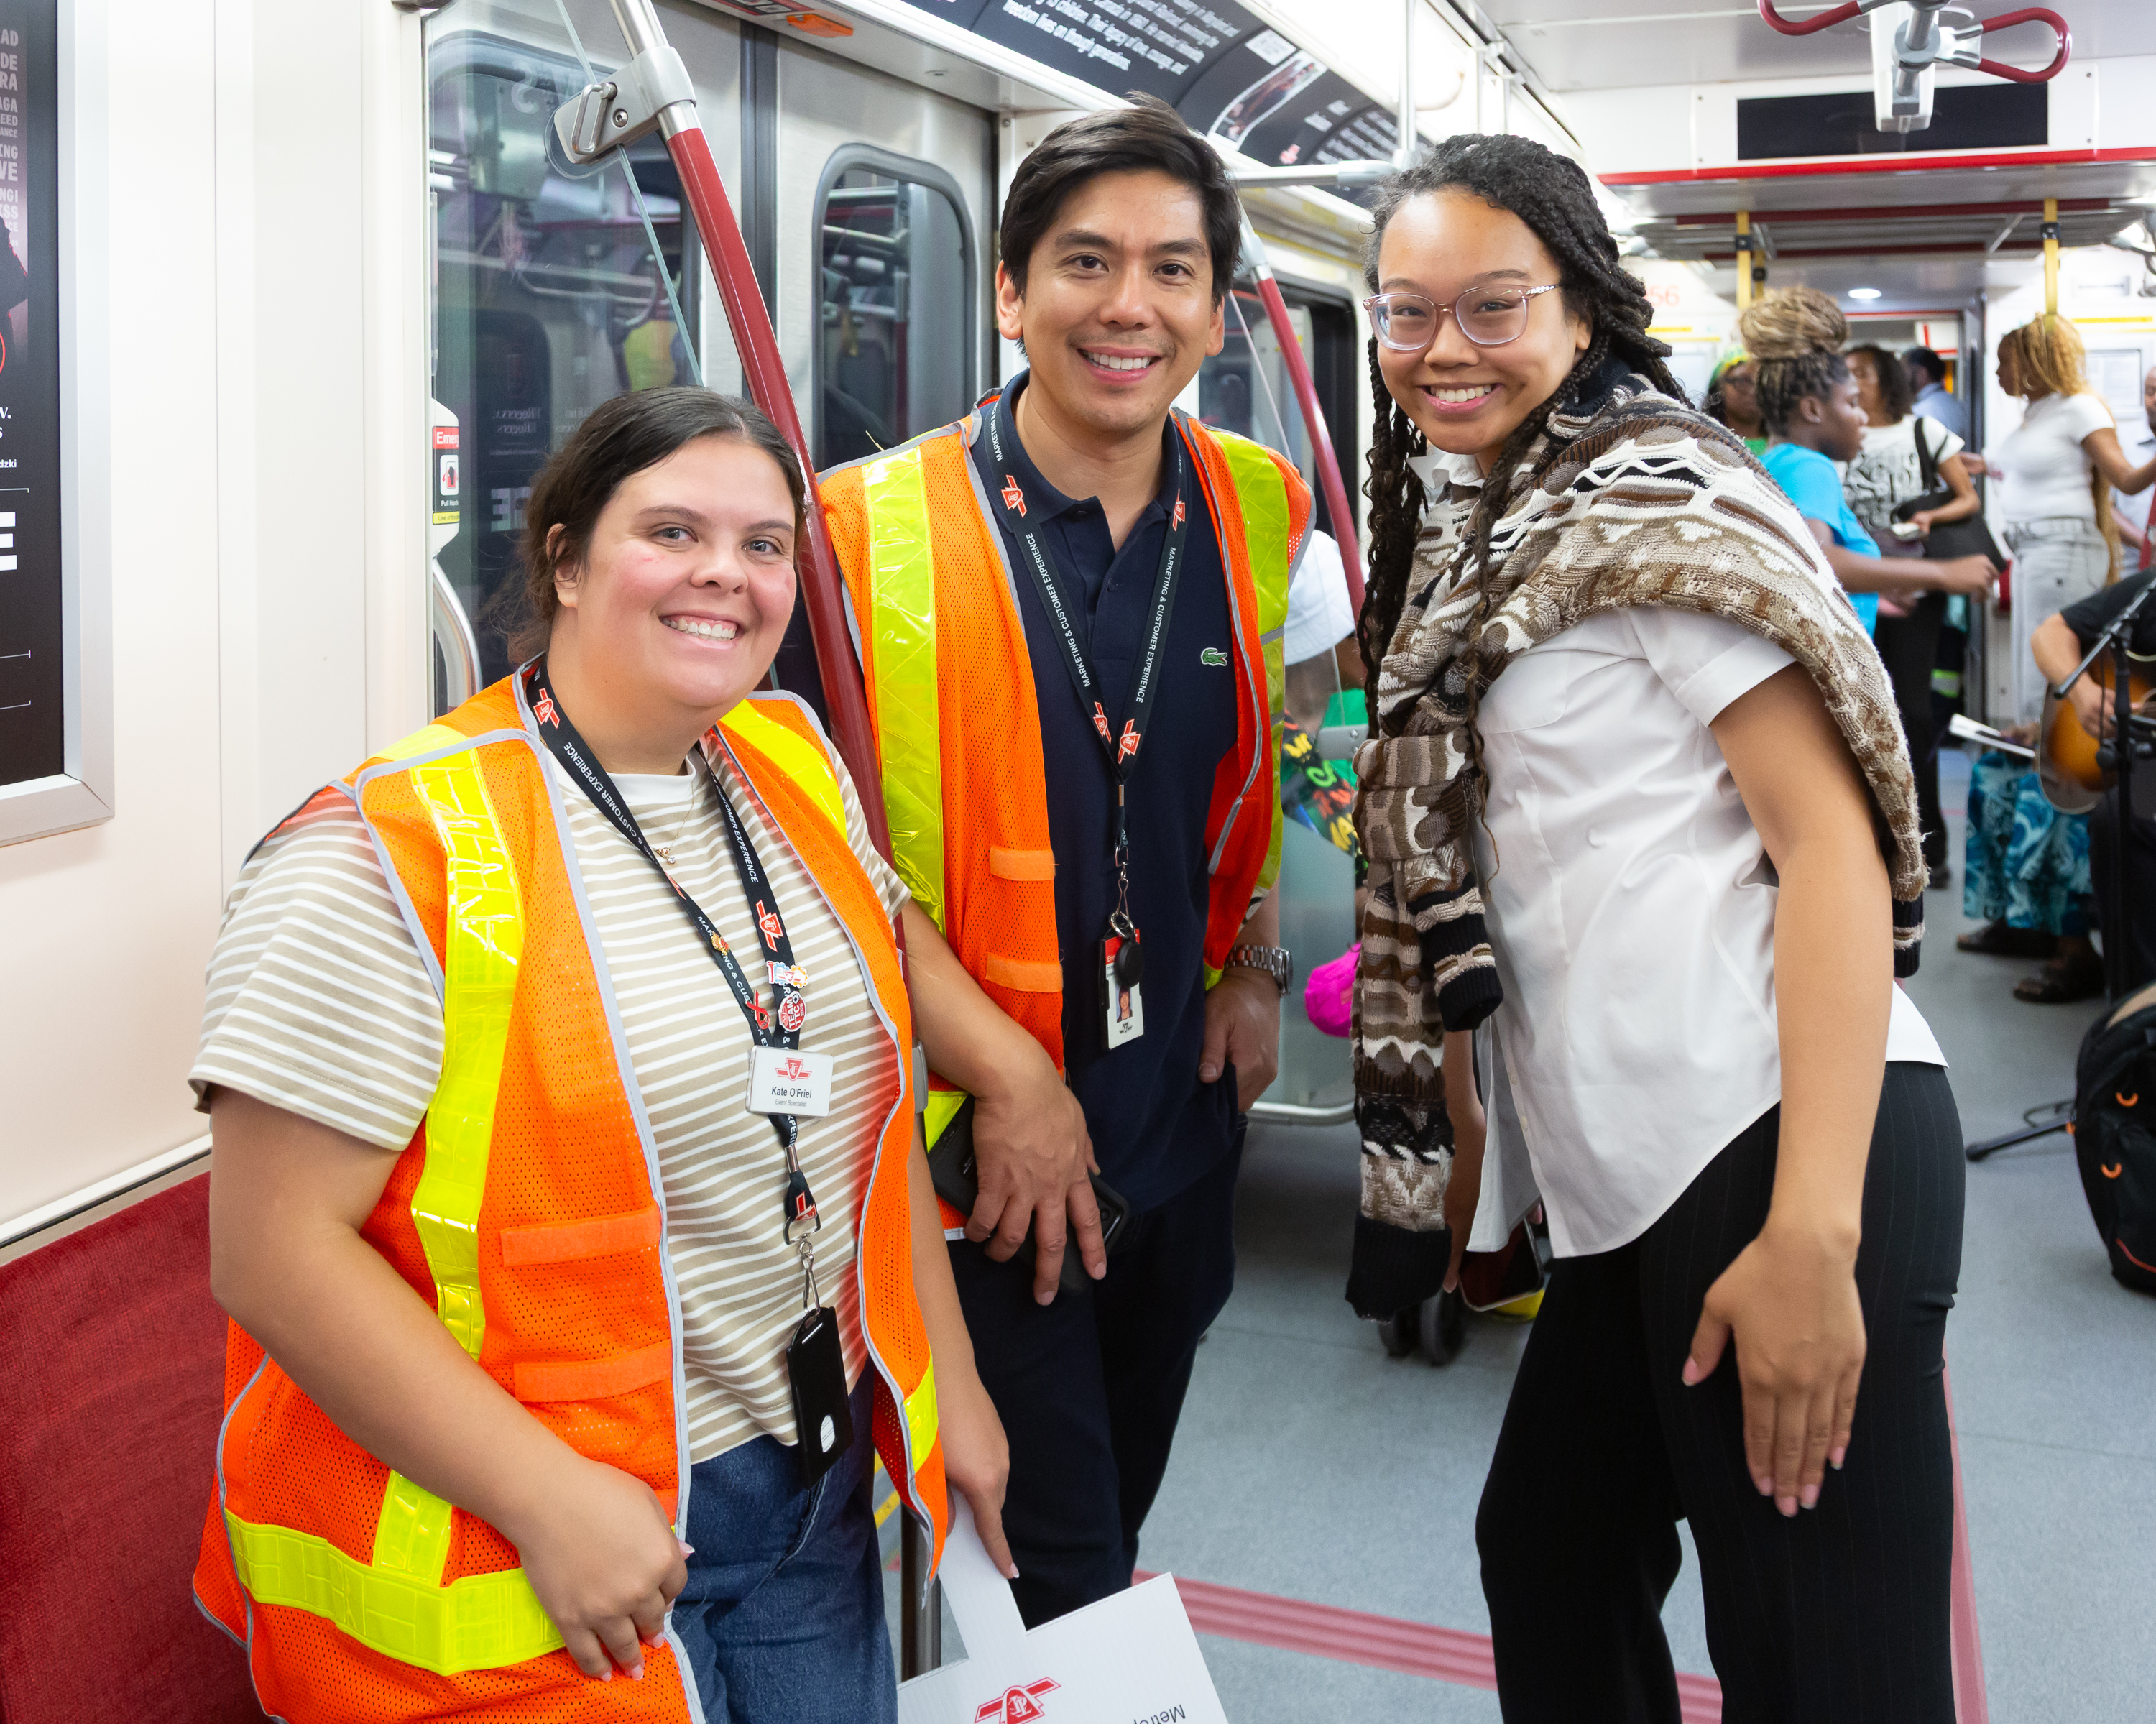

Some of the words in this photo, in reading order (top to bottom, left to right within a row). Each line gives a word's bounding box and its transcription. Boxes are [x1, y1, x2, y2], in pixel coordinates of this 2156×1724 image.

[1025, 533, 1051, 584] EXPERIENCE
[1161, 547, 1176, 596] MARKETING
[1046, 583, 1069, 630] CUSTOMER
[1148, 604, 1165, 650] CUSTOMER
[1067, 638, 1091, 688] MARKETING
[1135, 650, 1155, 704] EXPERIENCE
[563, 742, 604, 793] EXPERIENCE
[601, 790, 637, 838] CUSTOMER
[733, 830, 760, 883] EXPERIENCE
[786, 999, 795, 1028] TEAM
[771, 1087, 788, 1097] Kate
[789, 1088, 812, 1099] O'Friel
